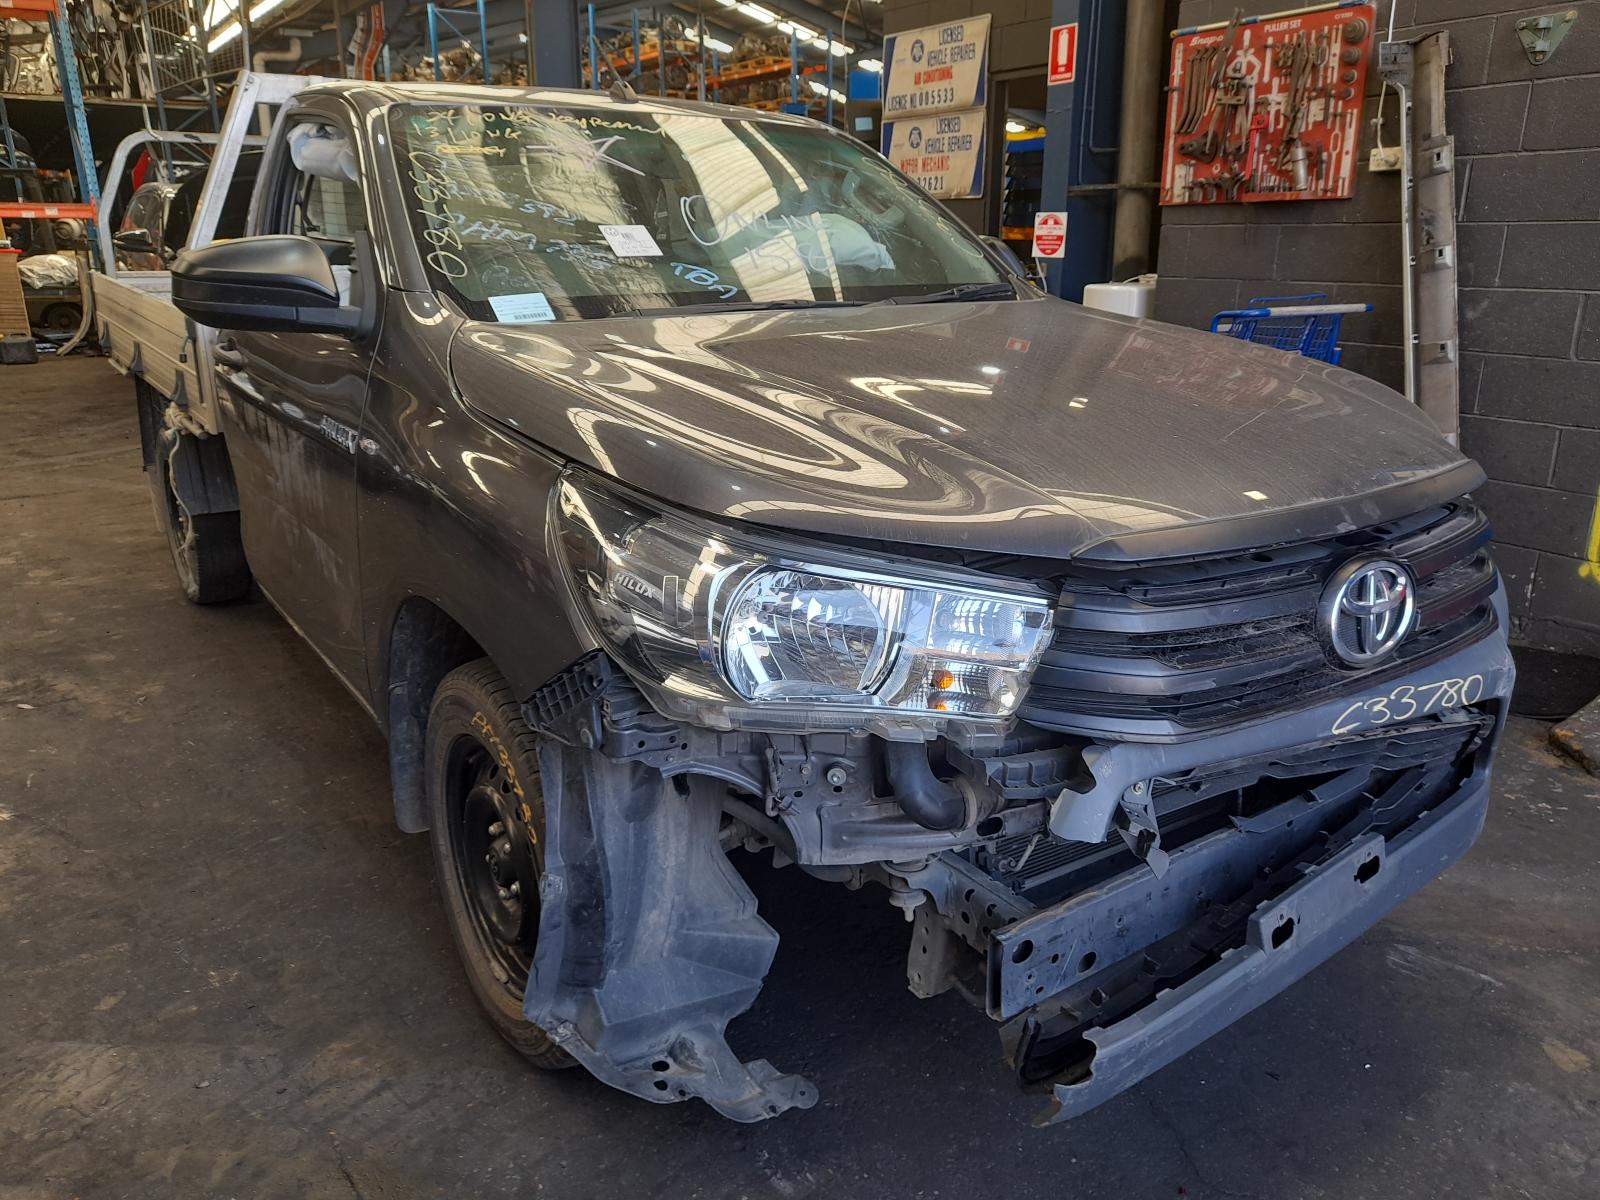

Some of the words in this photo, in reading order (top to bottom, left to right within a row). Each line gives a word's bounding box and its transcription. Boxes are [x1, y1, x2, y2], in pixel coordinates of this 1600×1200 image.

[938, 25, 964, 46] LICENSED
[1264, 21, 1288, 33] PULLER
[1289, 19, 1302, 30] SET
[927, 48, 948, 68] VEHICLE
[949, 42, 976, 63] REPAIRER
[919, 87, 954, 106] 005533
[935, 116, 961, 135] LICENSED
[925, 137, 946, 155] VEHICLE
[947, 134, 972, 153] REPAIRER
[613, 572, 656, 599] HILUX
[1331, 674, 1484, 735] C33780
